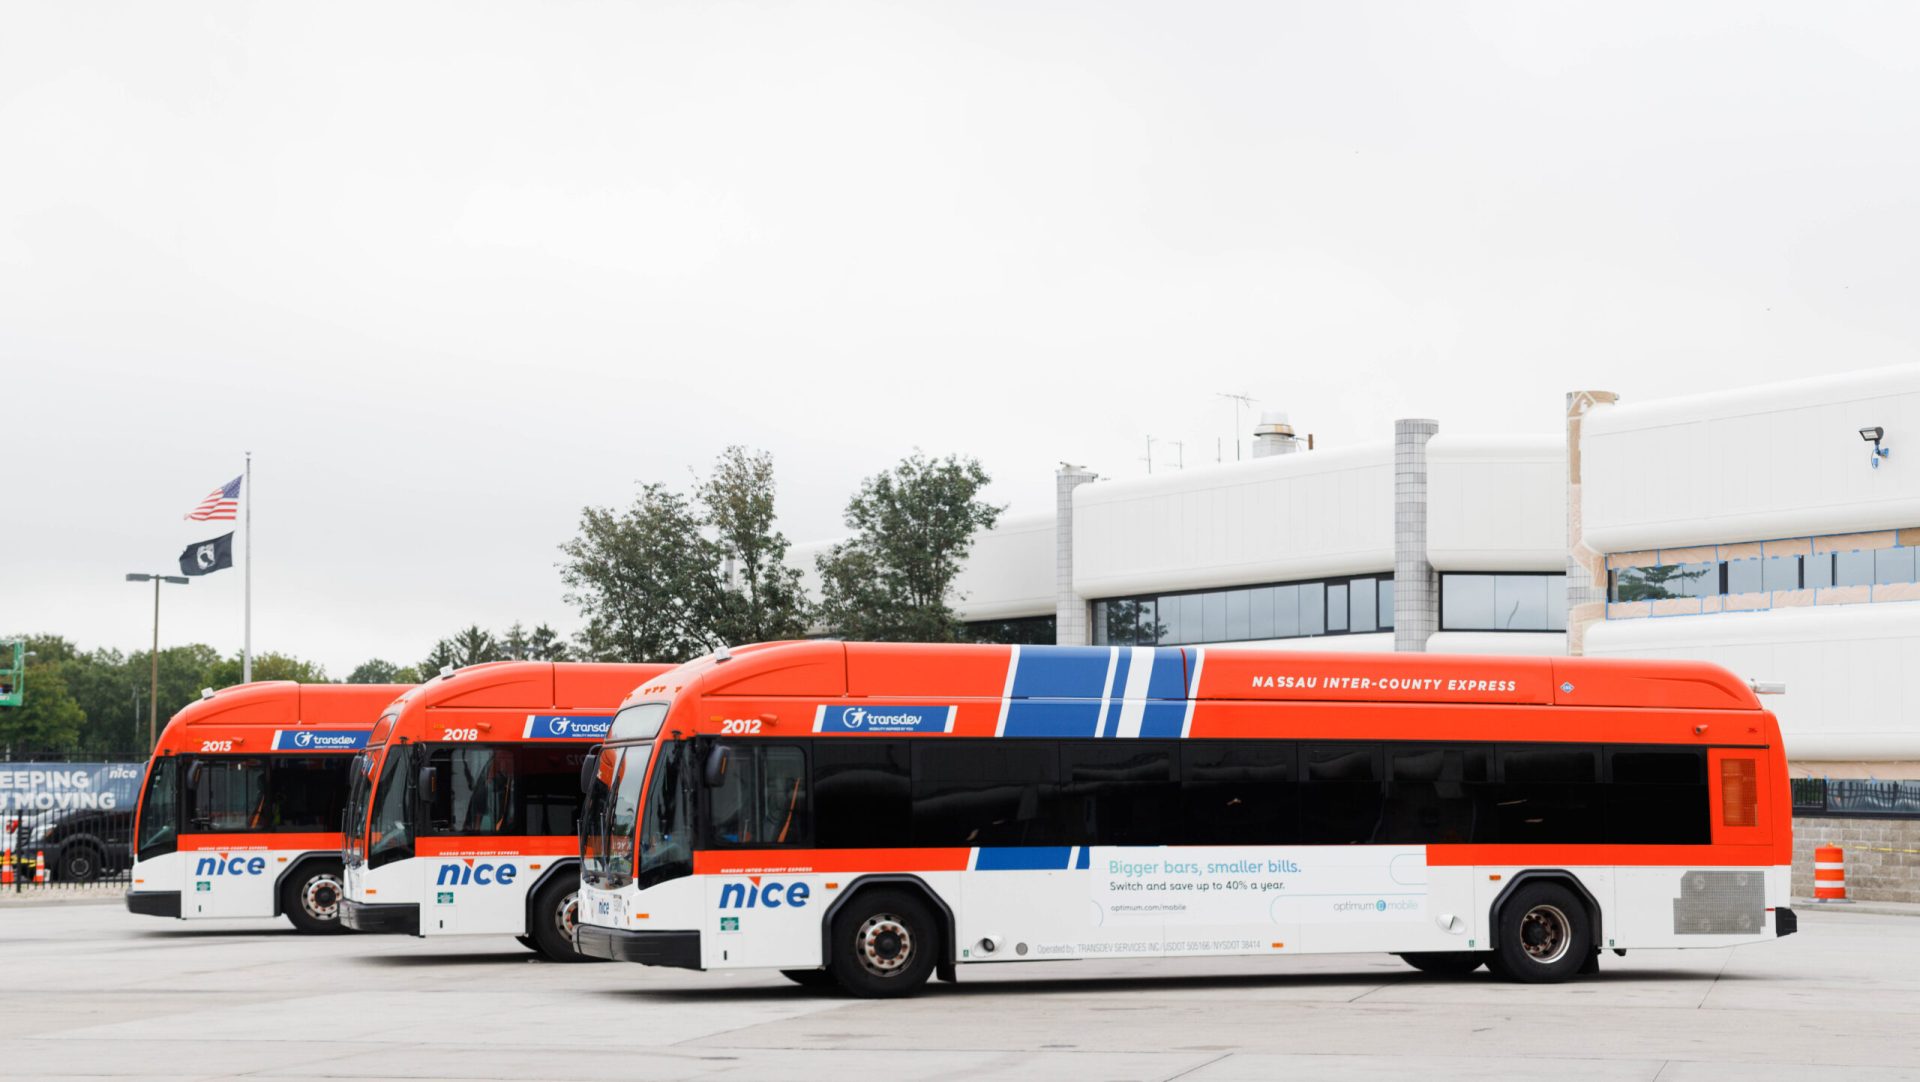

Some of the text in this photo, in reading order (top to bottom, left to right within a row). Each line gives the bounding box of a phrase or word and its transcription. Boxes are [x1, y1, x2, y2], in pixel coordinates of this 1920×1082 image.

[1252, 676, 1516, 691] NASSAU INTER-COUNTY EXPRESS
[867, 713, 922, 726] transdev
[721, 719, 762, 734] 2012
[313, 735, 356, 745] transdev
[442, 728, 478, 741] 2018
[200, 740, 232, 751] 2013
[109, 767, 137, 779] nice
[14, 792, 115, 809] MOVING
[196, 853, 266, 876] nice
[1109, 860, 1301, 877] Bigger bars, smaller bills.
[436, 858, 517, 885] nice
[719, 876, 811, 908] nice
[1110, 881, 1143, 891] Switch
[1146, 882, 1167, 891] and
[1170, 883, 1193, 891] save
[1197, 883, 1209, 892] up
[1213, 882, 1222, 890] to
[1226, 881, 1248, 890] 40%
[1260, 882, 1285, 892] year.
[1111, 904, 1187, 912] optimum.com/mobile
[1333, 900, 1418, 912] optimum mobile
[1036, 944, 1065, 954] Operated
[1077, 943, 1113, 953] TRANSDEV
[1114, 942, 1147, 952] SERVICES
